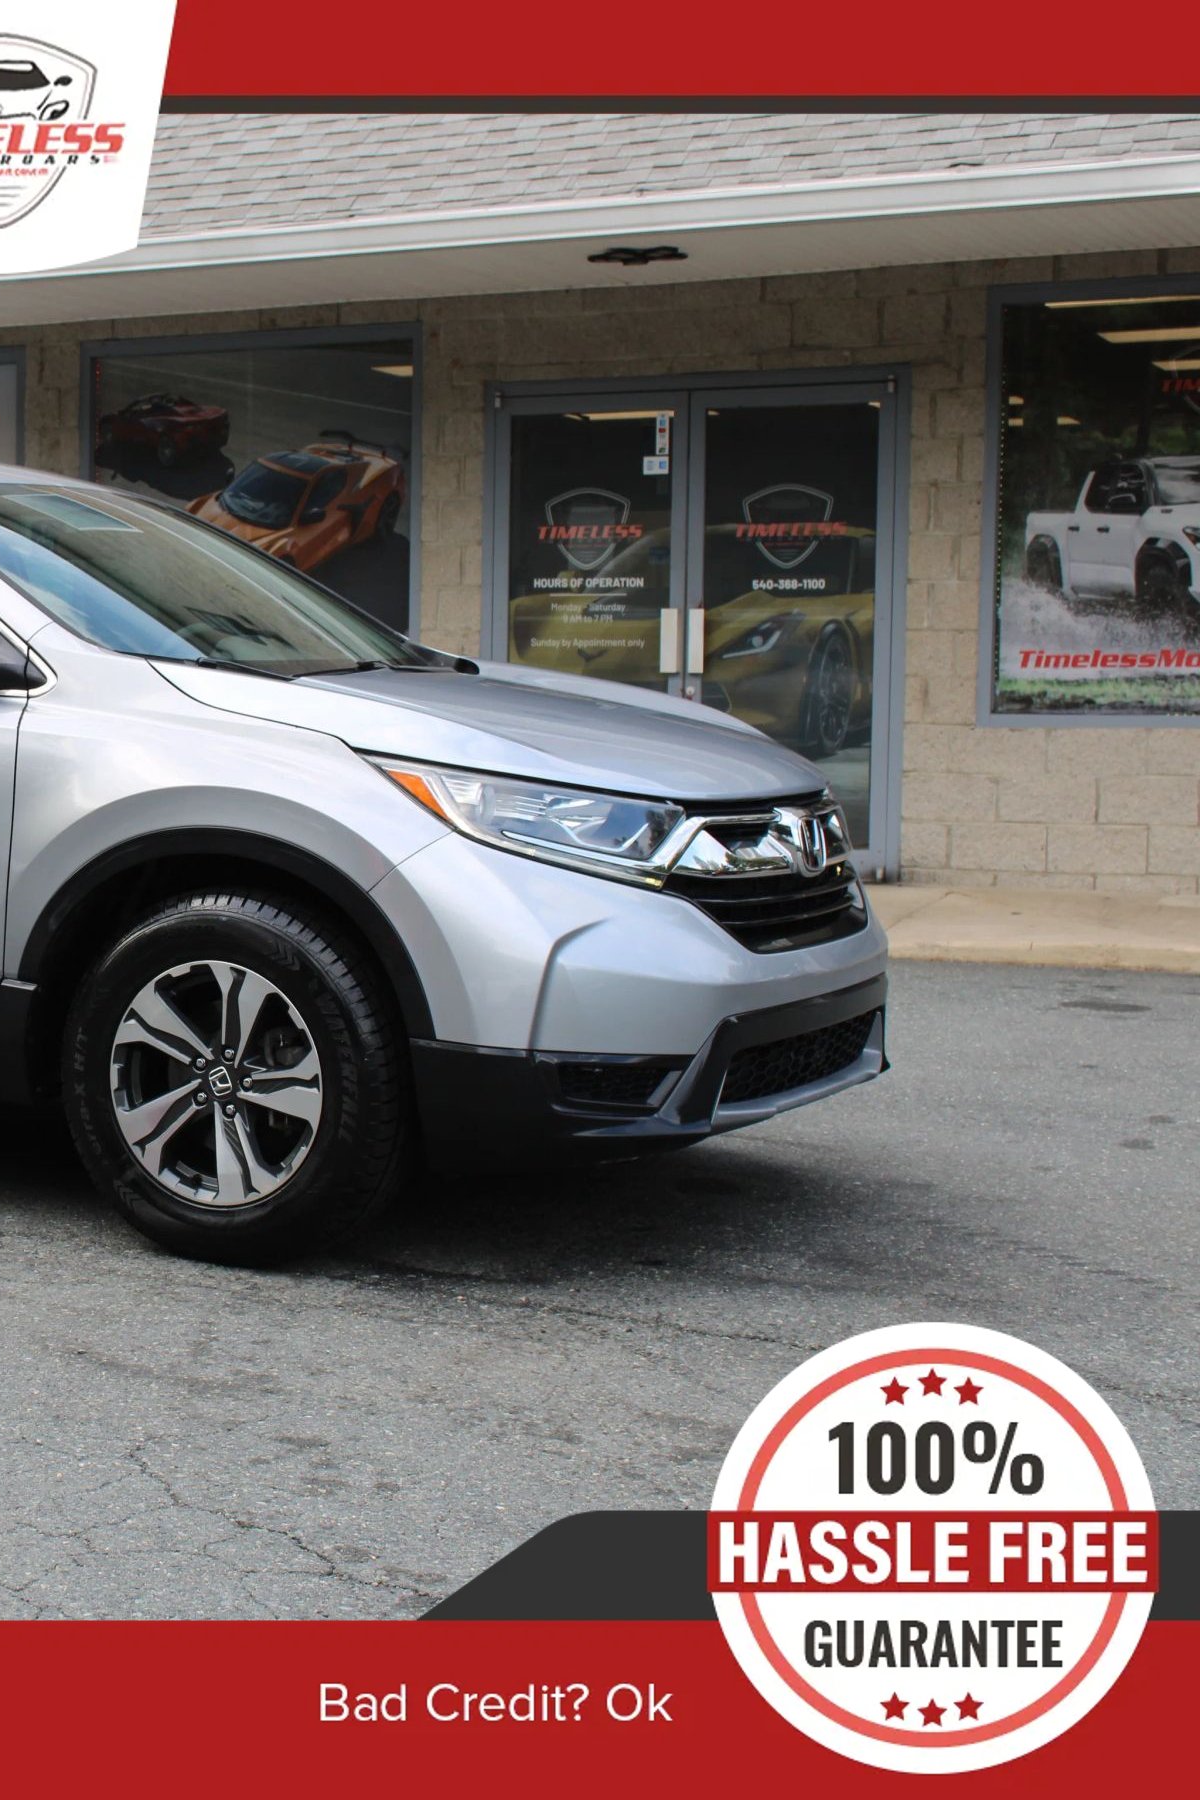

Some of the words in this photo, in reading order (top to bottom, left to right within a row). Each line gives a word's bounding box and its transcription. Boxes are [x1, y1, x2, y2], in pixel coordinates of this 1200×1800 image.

[538, 524, 643, 540] TIMELESS
[735, 521, 848, 538] TIMELESS
[533, 578, 568, 588] HOURS
[569, 578, 583, 588] OF
[585, 577, 644, 588] OPERATION
[752, 579, 826, 590] 540-368-1100
[551, 603, 581, 614] Monday
[530, 637, 561, 649] Sunday
[562, 638, 571, 648] by
[573, 638, 626, 649] Appointment
[627, 638, 645, 648] only
